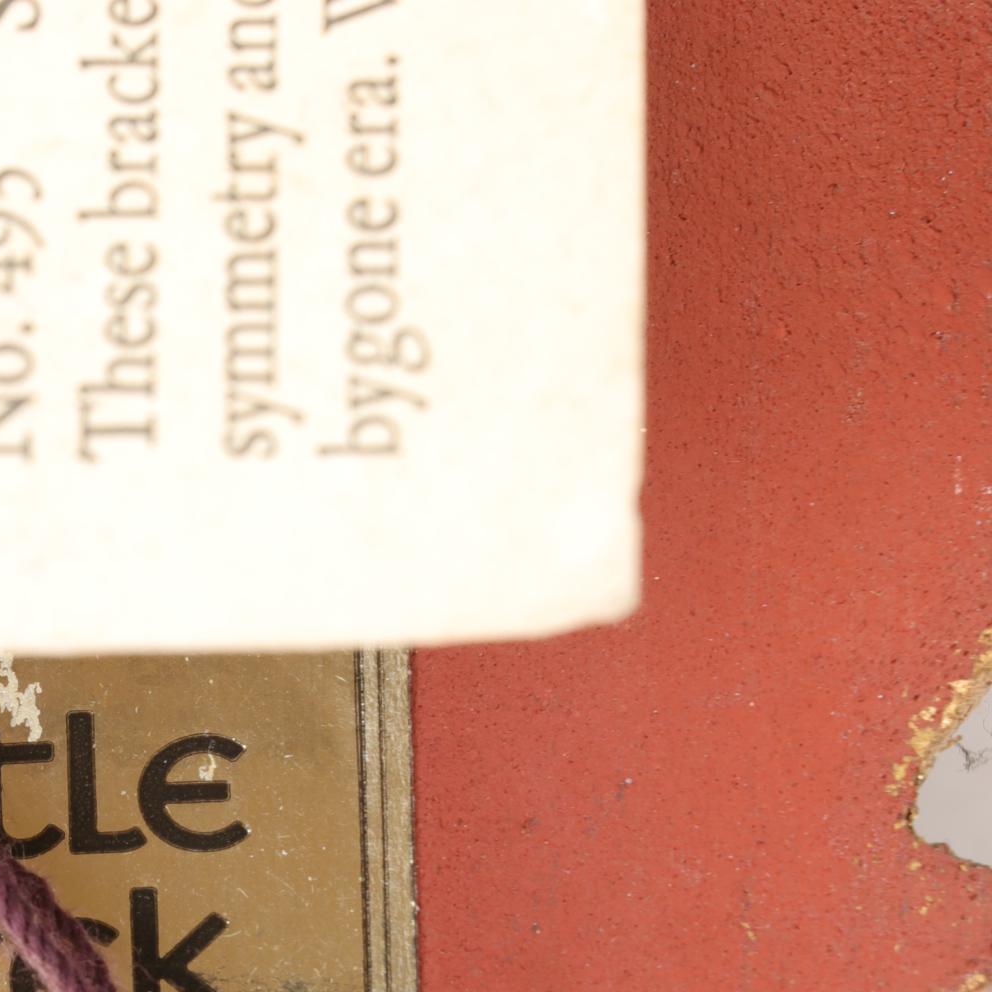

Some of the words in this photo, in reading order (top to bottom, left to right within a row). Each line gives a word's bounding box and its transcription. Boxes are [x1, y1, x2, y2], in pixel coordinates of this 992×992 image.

[227, 0, 280, 94] an
[344, 53, 401, 179] era.
[76, 241, 160, 464] These
[214, 110, 307, 458] symmetry
[317, 195, 432, 456] bygone
